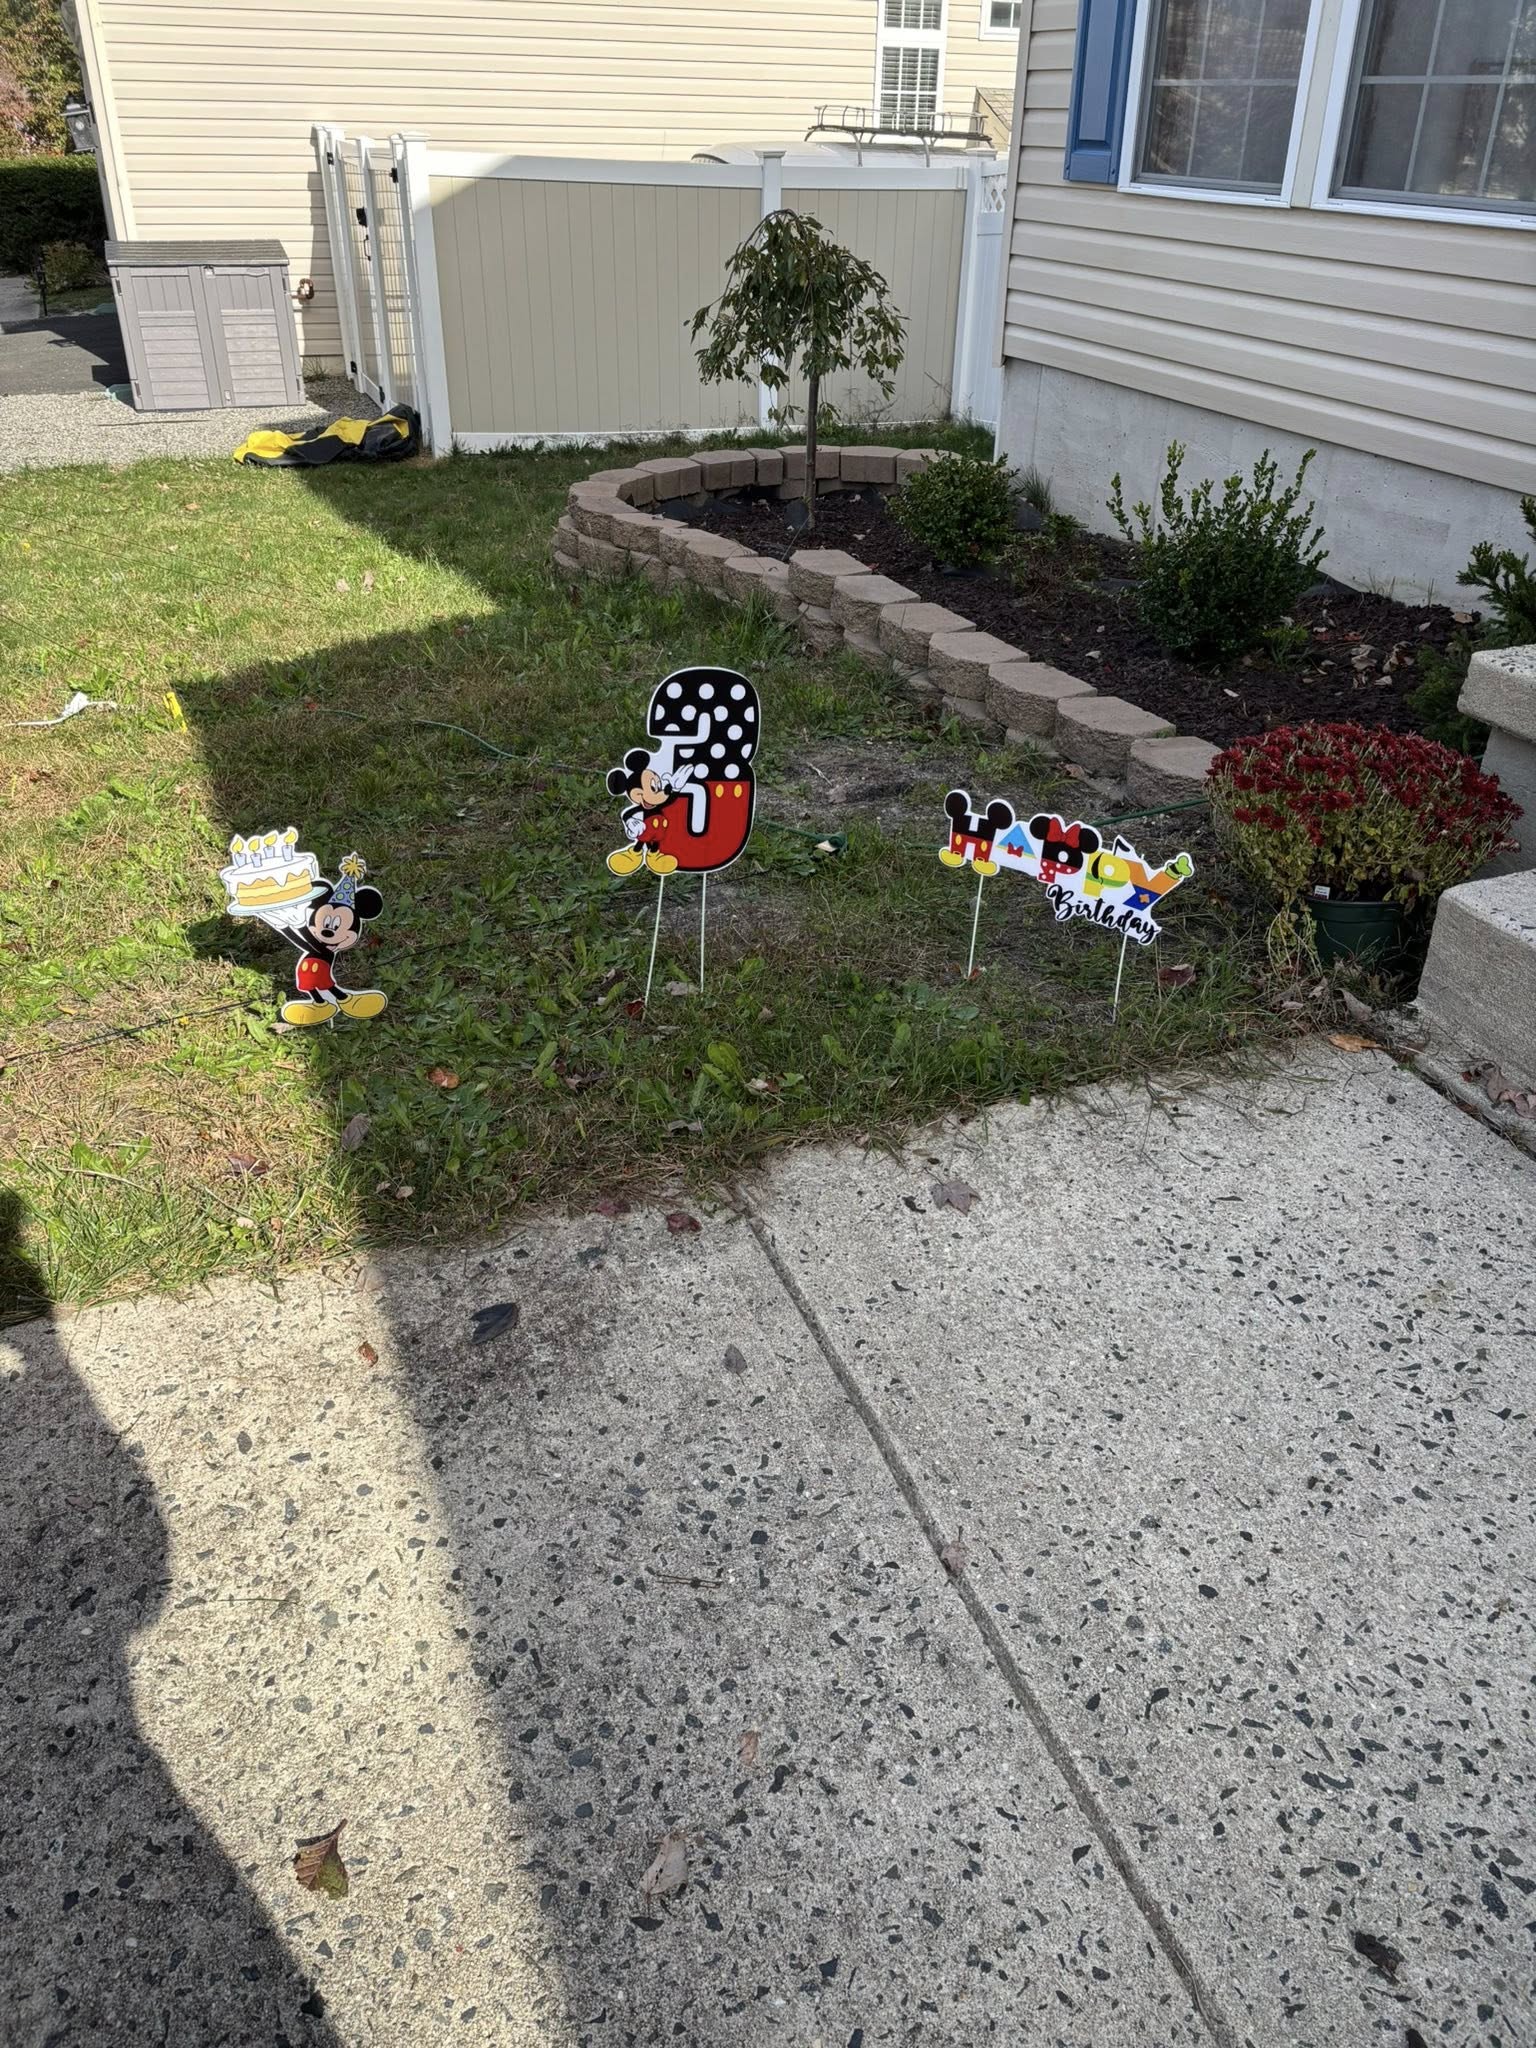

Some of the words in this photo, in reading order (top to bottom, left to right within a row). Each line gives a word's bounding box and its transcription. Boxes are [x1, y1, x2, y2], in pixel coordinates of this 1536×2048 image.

[651, 668, 759, 870] 3
[943, 793, 1184, 911] HAPPY
[1048, 885, 1158, 943] Birthday
